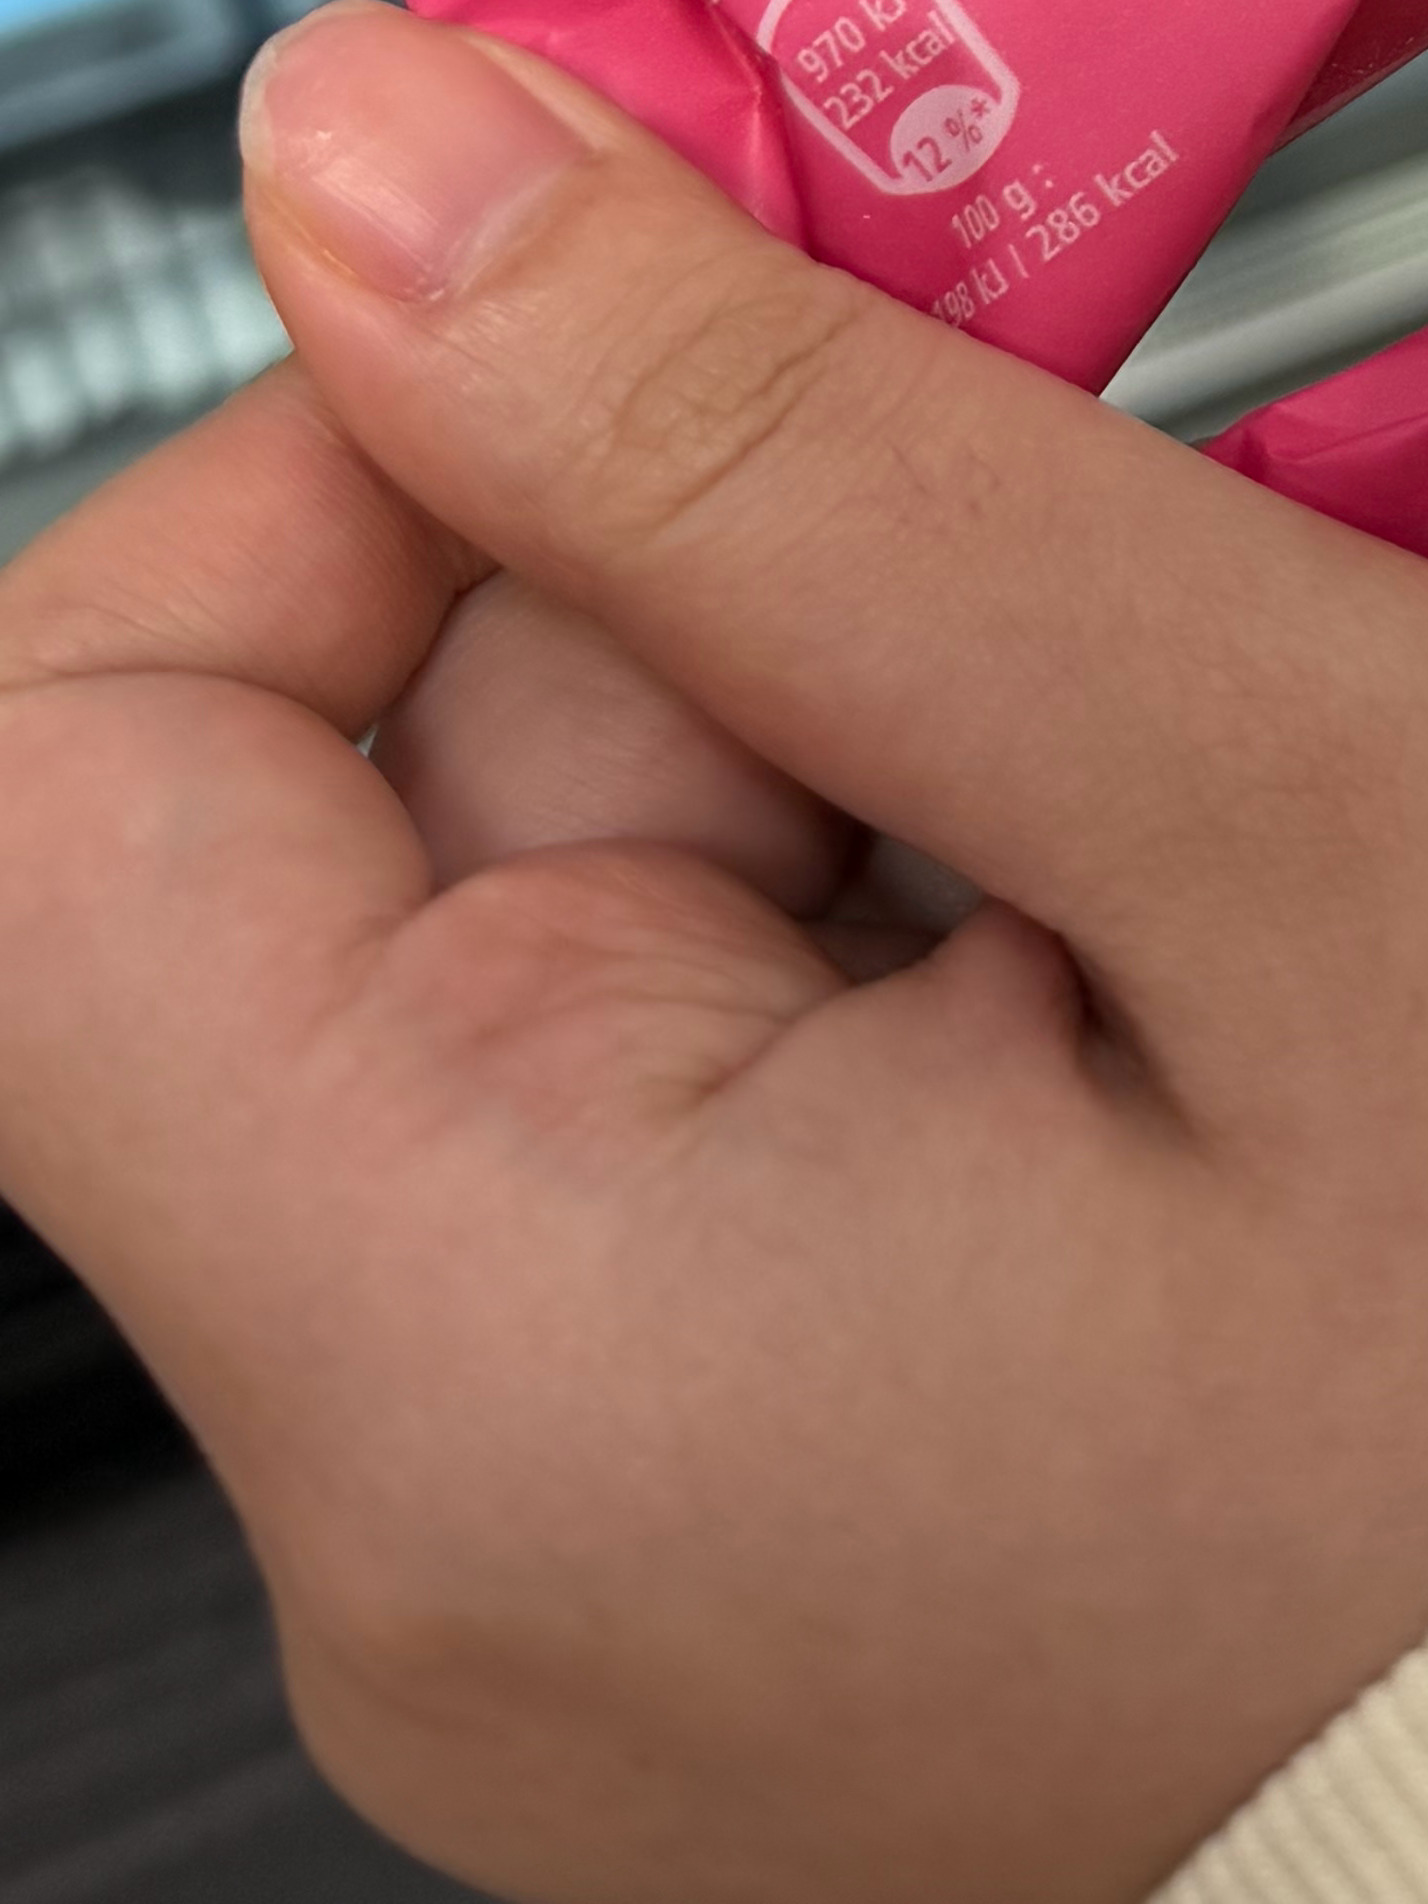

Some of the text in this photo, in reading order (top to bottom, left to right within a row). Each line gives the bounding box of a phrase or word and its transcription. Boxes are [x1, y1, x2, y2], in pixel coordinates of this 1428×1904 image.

[797, 16, 867, 83] 970
[823, 10, 956, 130] 232 kcal
[902, 136, 953, 183] 12
[951, 194, 1000, 249] 100
[1003, 179, 1038, 222] g
[970, 258, 1010, 305] kJ
[1008, 243, 1030, 279] /
[1025, 191, 1101, 262] 286
[1094, 129, 1180, 207] kcal
